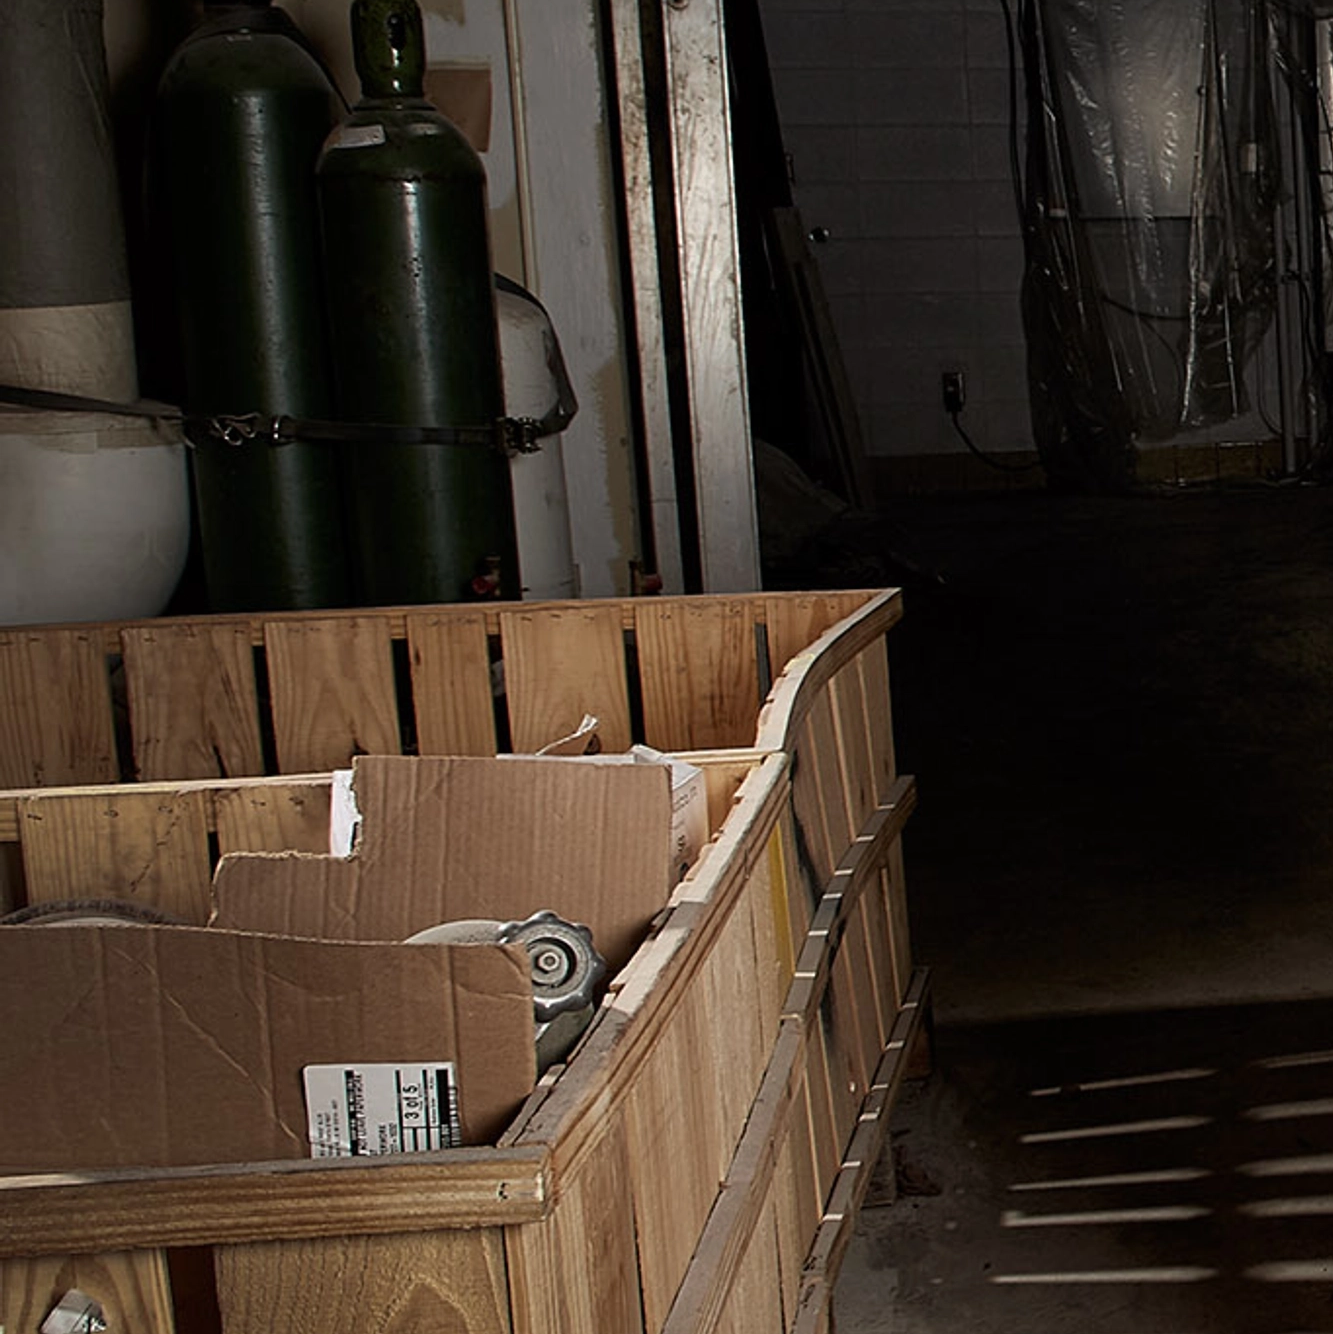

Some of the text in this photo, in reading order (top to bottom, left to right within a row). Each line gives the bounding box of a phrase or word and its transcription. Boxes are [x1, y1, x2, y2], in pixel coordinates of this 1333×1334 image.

[402, 1084, 420, 1120] 3 of 5
